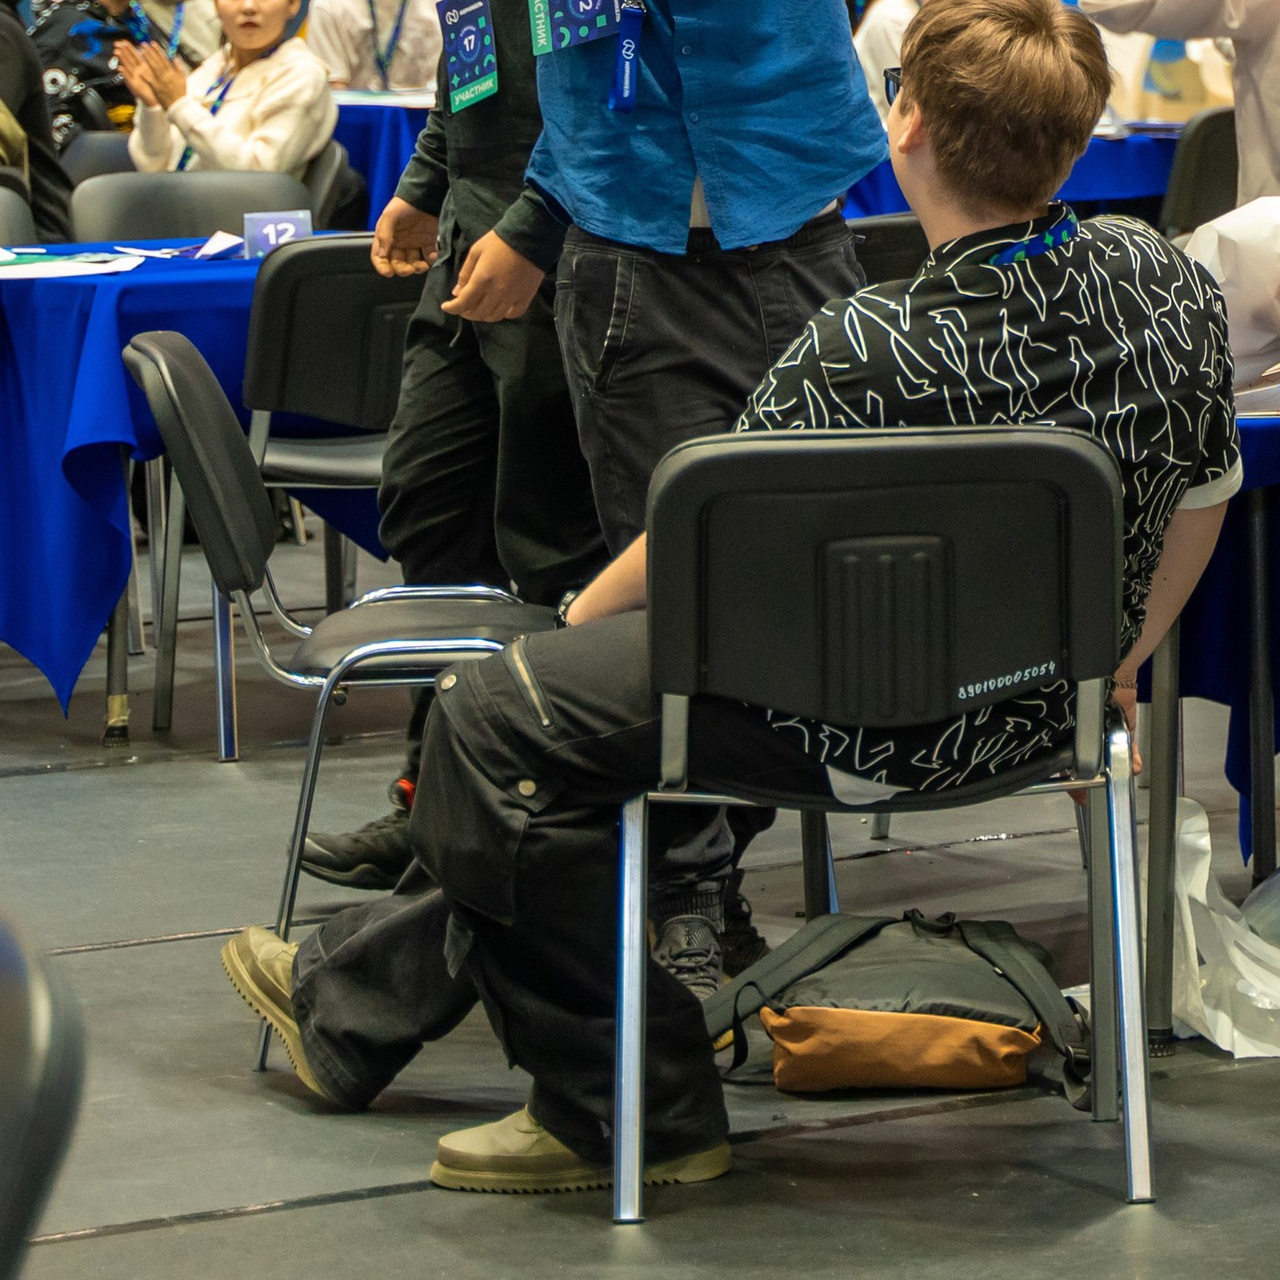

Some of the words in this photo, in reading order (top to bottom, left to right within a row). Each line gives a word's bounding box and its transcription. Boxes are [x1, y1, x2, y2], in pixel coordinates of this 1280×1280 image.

[463, 34, 475, 51] 17
[454, 78, 494, 106] УЧАСТНИК
[263, 222, 296, 245] 12
